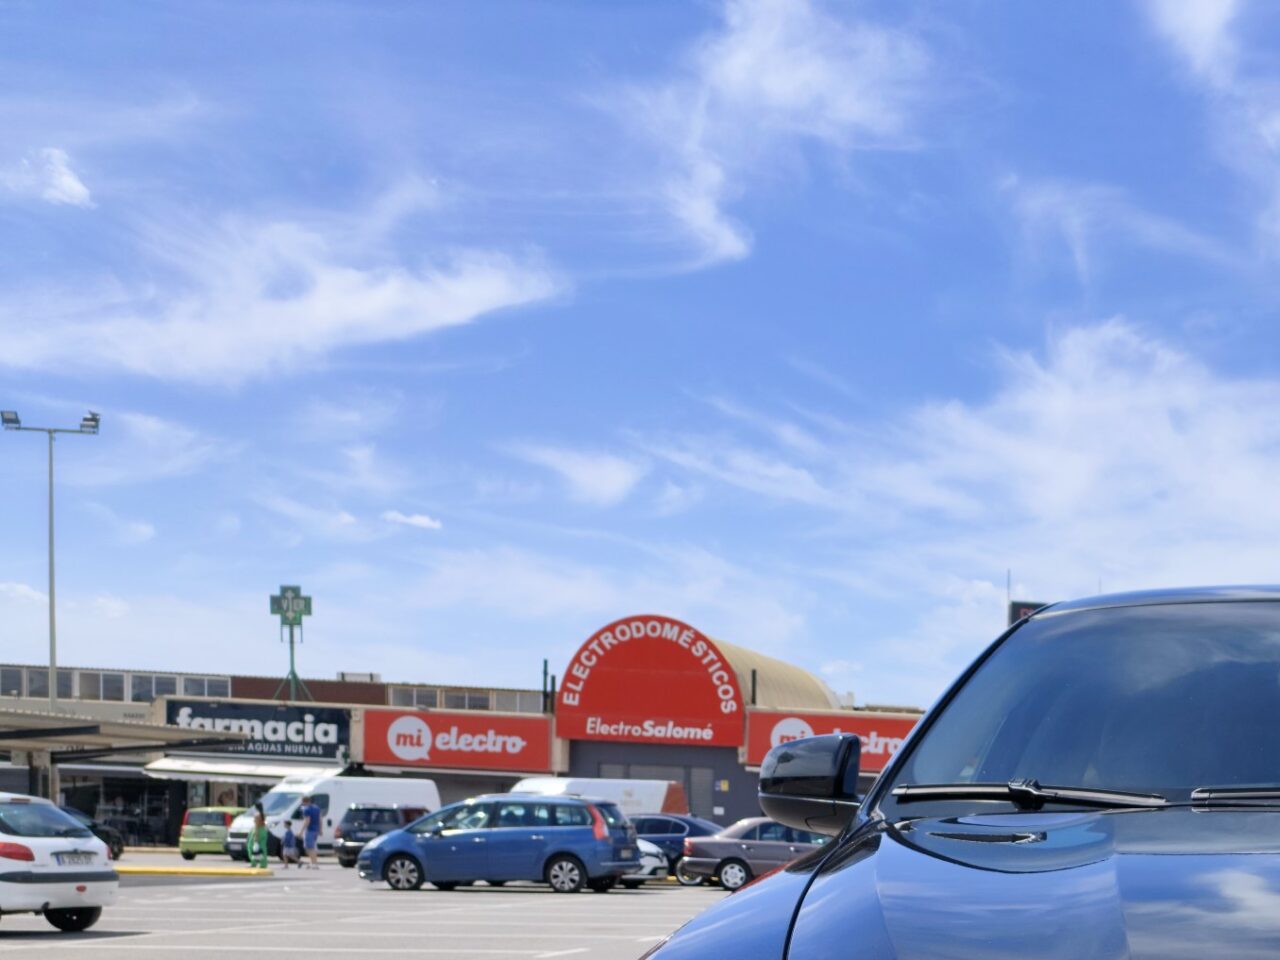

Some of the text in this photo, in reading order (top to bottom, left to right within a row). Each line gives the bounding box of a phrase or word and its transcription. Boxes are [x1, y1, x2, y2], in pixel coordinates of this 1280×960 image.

[563, 620, 737, 714] ELECTRODOMÉSTICOS
[176, 706, 338, 743] farmacia
[395, 726, 527, 754] mi electro
[248, 742, 282, 753] AGUAS
[284, 745, 324, 755] NUEVAS
